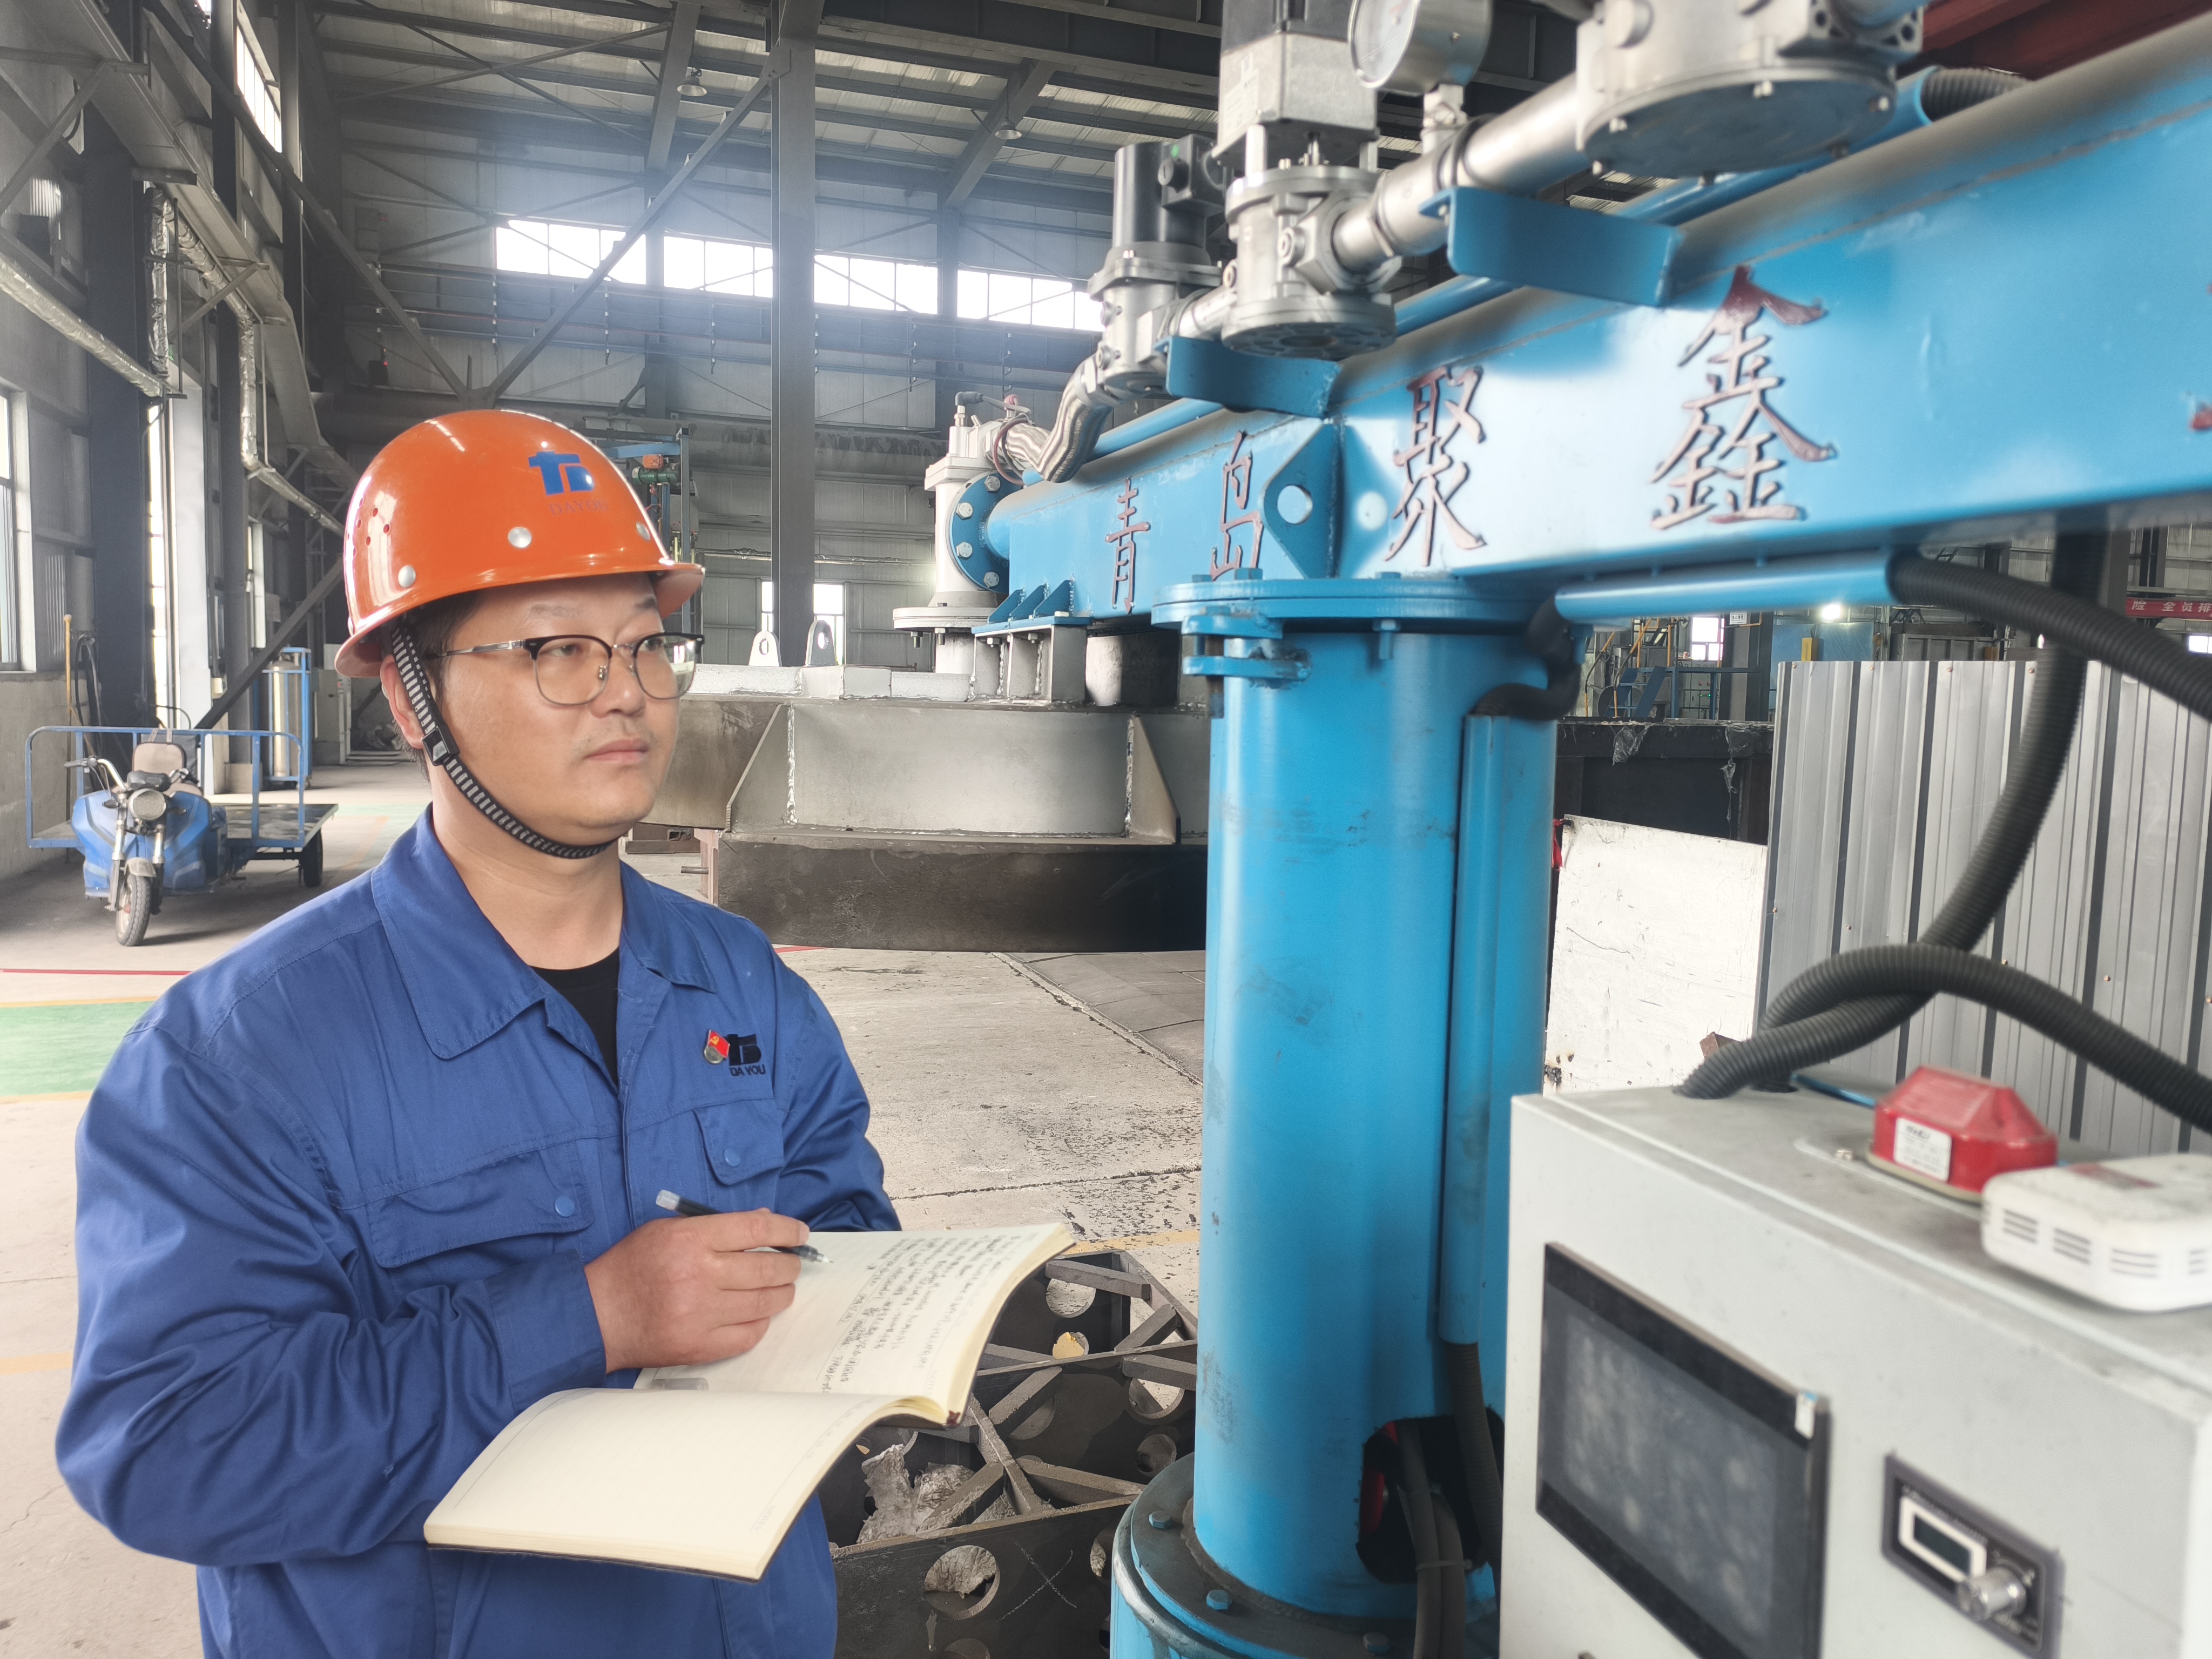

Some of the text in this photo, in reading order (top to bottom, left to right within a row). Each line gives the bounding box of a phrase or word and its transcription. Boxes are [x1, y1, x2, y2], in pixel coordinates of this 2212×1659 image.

[730, 1064, 766, 1076] DA YOU
[754, 1505, 777, 1530] NOTES
